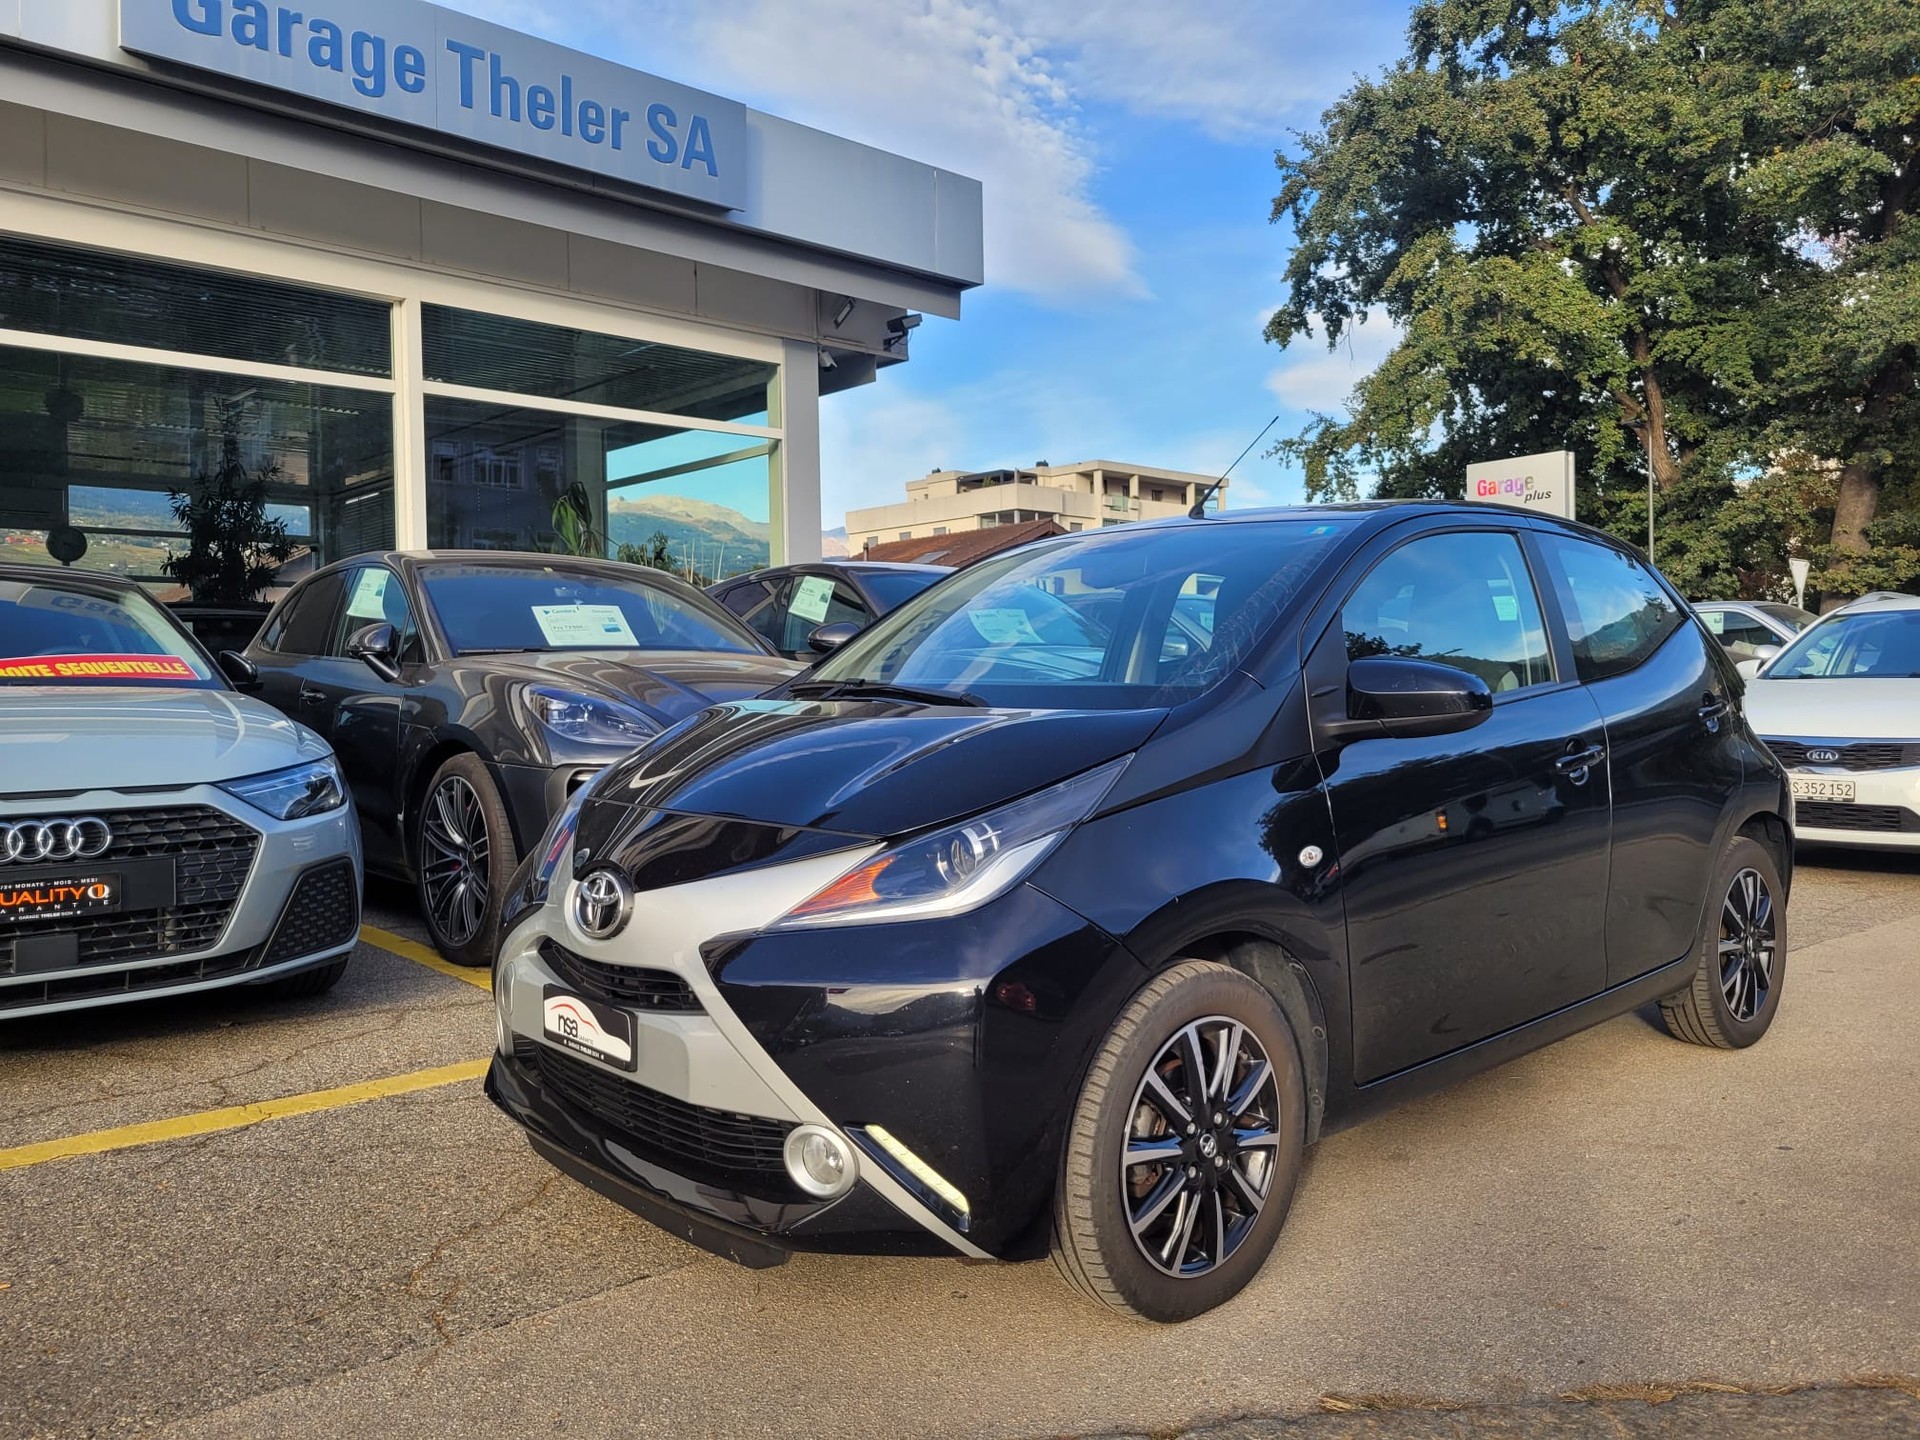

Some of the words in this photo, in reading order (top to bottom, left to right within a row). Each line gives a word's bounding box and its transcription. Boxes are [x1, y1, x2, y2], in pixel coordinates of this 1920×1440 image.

[446, 38, 630, 151] Theler
[645, 102, 718, 178] SA
[1477, 476, 1534, 496] Garage
[1524, 490, 1552, 503] plus
[55, 661, 190, 676] SEQUENTIELLE
[1812, 751, 1833, 760] KIA
[1829, 783, 1852, 796] 152
[558, 1013, 578, 1038] nsa
